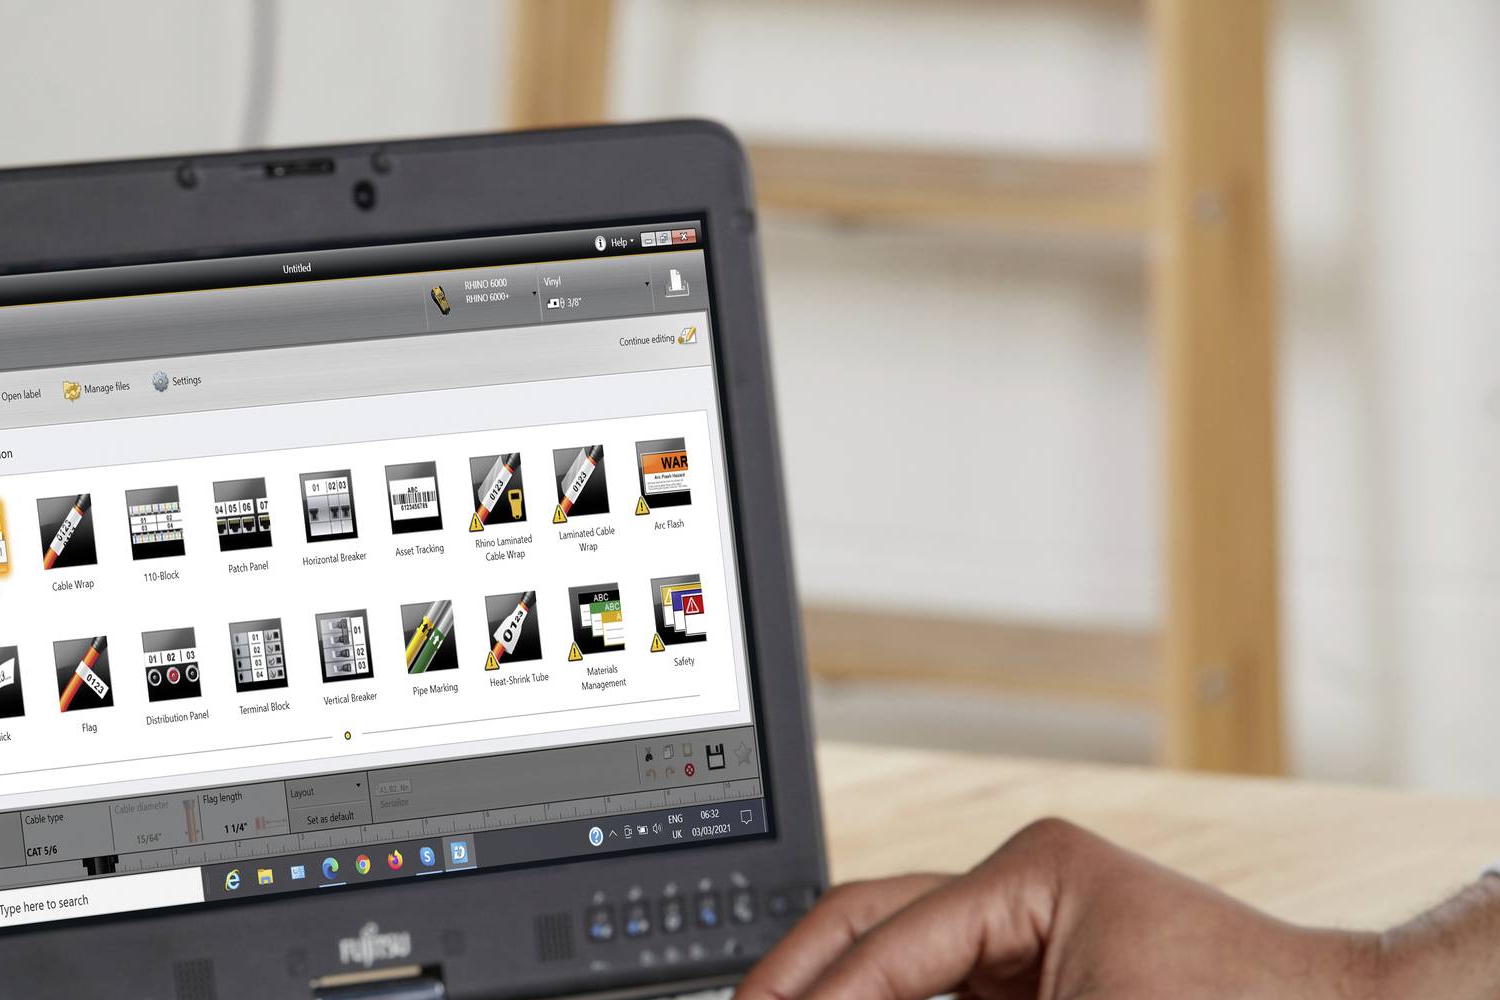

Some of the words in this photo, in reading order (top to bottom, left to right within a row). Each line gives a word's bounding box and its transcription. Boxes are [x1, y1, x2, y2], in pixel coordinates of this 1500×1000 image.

[611, 238, 627, 248] Help
[283, 262, 312, 274] Untitled
[464, 281, 489, 289] RHINO
[490, 279, 507, 288] 6000
[543, 276, 561, 287] Vinyl
[466, 295, 488, 303] RHINO
[490, 293, 509, 302] 6000+
[619, 336, 650, 346] Continue
[651, 334, 675, 345] editing
[172, 376, 201, 387] Settings
[84, 384, 114, 395] Manage
[115, 382, 130, 390] files
[2, 392, 22, 403] Open
[23, 389, 41, 399] label
[661, 455, 688, 469] WAR
[328, 482, 336, 490] 02
[338, 481, 346, 489] 03
[572, 472, 587, 493] 0123
[490, 479, 504, 501] 0123
[215, 505, 223, 514] 04
[228, 504, 237, 513] 05
[242, 502, 251, 511] 06
[260, 501, 268, 510] 07
[654, 521, 666, 530] Arc
[667, 519, 684, 528] Flash
[56, 520, 72, 542] 0123
[559, 528, 594, 540] Laminated
[596, 526, 615, 536] Cable
[475, 539, 495, 548] Rhino
[497, 534, 532, 546] Laminated
[395, 545, 414, 556] Asset
[415, 544, 444, 555] Tracking
[579, 543, 598, 552] Wrap
[302, 554, 339, 566] Horizontal
[341, 552, 366, 562] Breaker
[486, 552, 505, 561] Cable
[506, 551, 525, 560] Wrap
[228, 564, 248, 573] Patch
[250, 561, 269, 571] Panel
[144, 570, 179, 582] 110-Block
[52, 581, 73, 591] Cable
[74, 580, 95, 591] Wrap
[593, 593, 609, 602] ABC
[605, 602, 620, 611] ABC
[353, 626, 361, 634] 01
[148, 655, 157, 663] 01
[167, 653, 176, 662] 02
[186, 651, 195, 659] 03
[357, 648, 364, 656] 02
[358, 661, 366, 670] 03
[674, 657, 695, 666] Safety
[587, 665, 618, 676] Materials
[86, 673, 104, 694] 0123
[490, 674, 530, 687] Heat-Shrink
[532, 673, 549, 682] Tube
[582, 678, 627, 691] Management
[413, 686, 428, 696] Pipe
[430, 684, 458, 693] Marking
[323, 695, 350, 705] Vertical
[351, 692, 377, 702] Breaker
[239, 703, 269, 715] Terminal
[271, 701, 290, 711] Block
[146, 713, 188, 725] Distribution
[190, 710, 209, 720] Panel
[82, 723, 98, 733] Flag
[203, 794, 218, 805] Flag
[219, 792, 242, 803] length
[290, 788, 314, 799] Layout
[25, 815, 46, 825] Cable
[47, 814, 64, 824] type
[307, 815, 318, 825] Set
[330, 811, 354, 822] default
[668, 814, 683, 824] ENG
[701, 809, 719, 819] 06:32
[672, 830, 683, 839] UK
[692, 824, 731, 836] 03/03/2021
[27, 847, 42, 857] CAT
[44, 845, 58, 855] 5/6
[0, 904, 21, 917] Type
[23, 901, 44, 912] here
[46, 900, 57, 910] to
[58, 894, 89, 908] search
